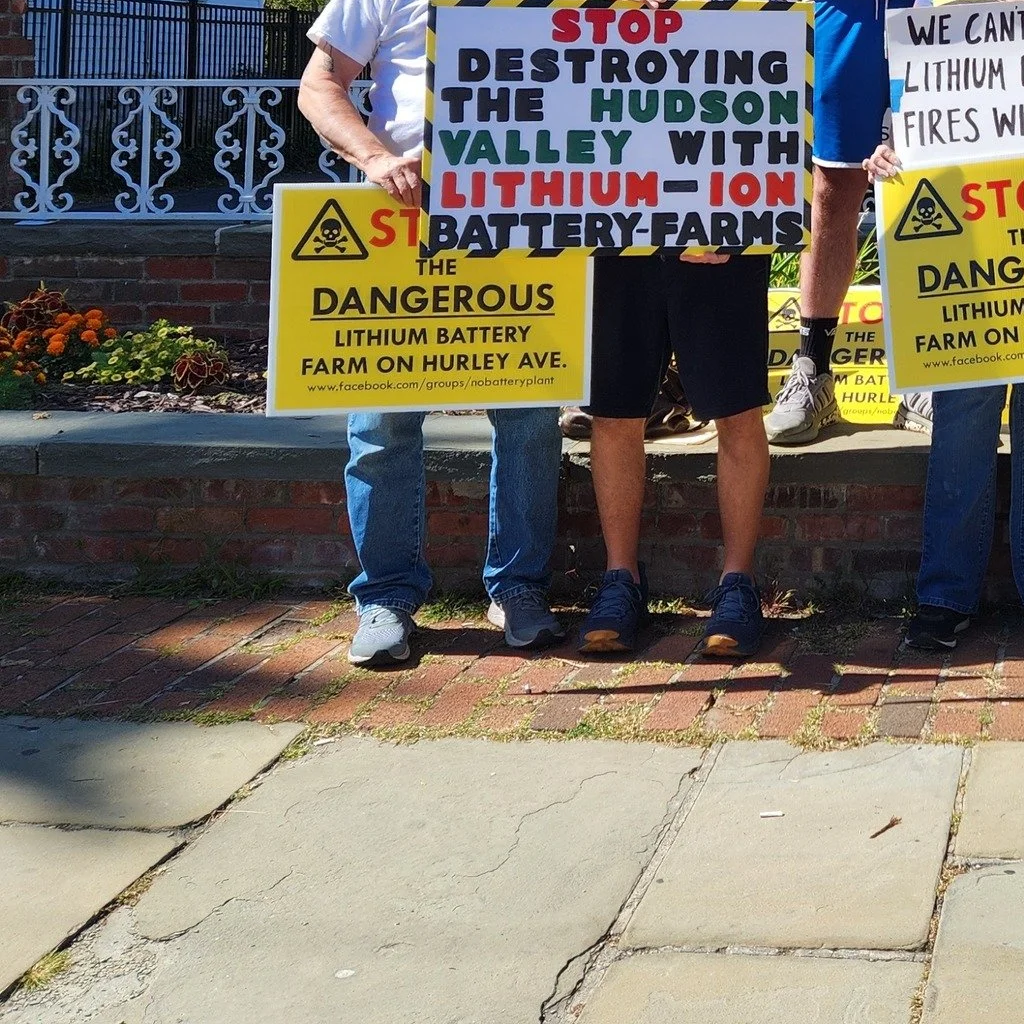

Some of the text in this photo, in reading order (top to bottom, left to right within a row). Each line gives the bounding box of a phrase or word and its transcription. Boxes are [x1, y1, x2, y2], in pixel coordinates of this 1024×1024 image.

[552, 9, 683, 44] STOP
[907, 14, 951, 46] WE
[458, 48, 788, 84] DESTROYING
[904, 57, 1006, 93] LITHIUM
[441, 87, 798, 124] THE HUDSON
[903, 107, 980, 148] FIRES
[438, 129, 799, 166] VALLEY WITH
[368, 208, 420, 248] ST
[415, 259, 456, 276] THE
[312, 283, 555, 315] DANGEROUS
[335, 326, 531, 348] LITHIUM BATTERY
[846, 332, 875, 342] THE
[915, 330, 977, 354] FARM
[984, 328, 1020, 346] ON
[301, 351, 567, 376] FARM ON HURLEY AVE.
[307, 376, 555, 392] www.facebook.com/groups/nobatteryplant
[842, 392, 896, 403] HURLE
